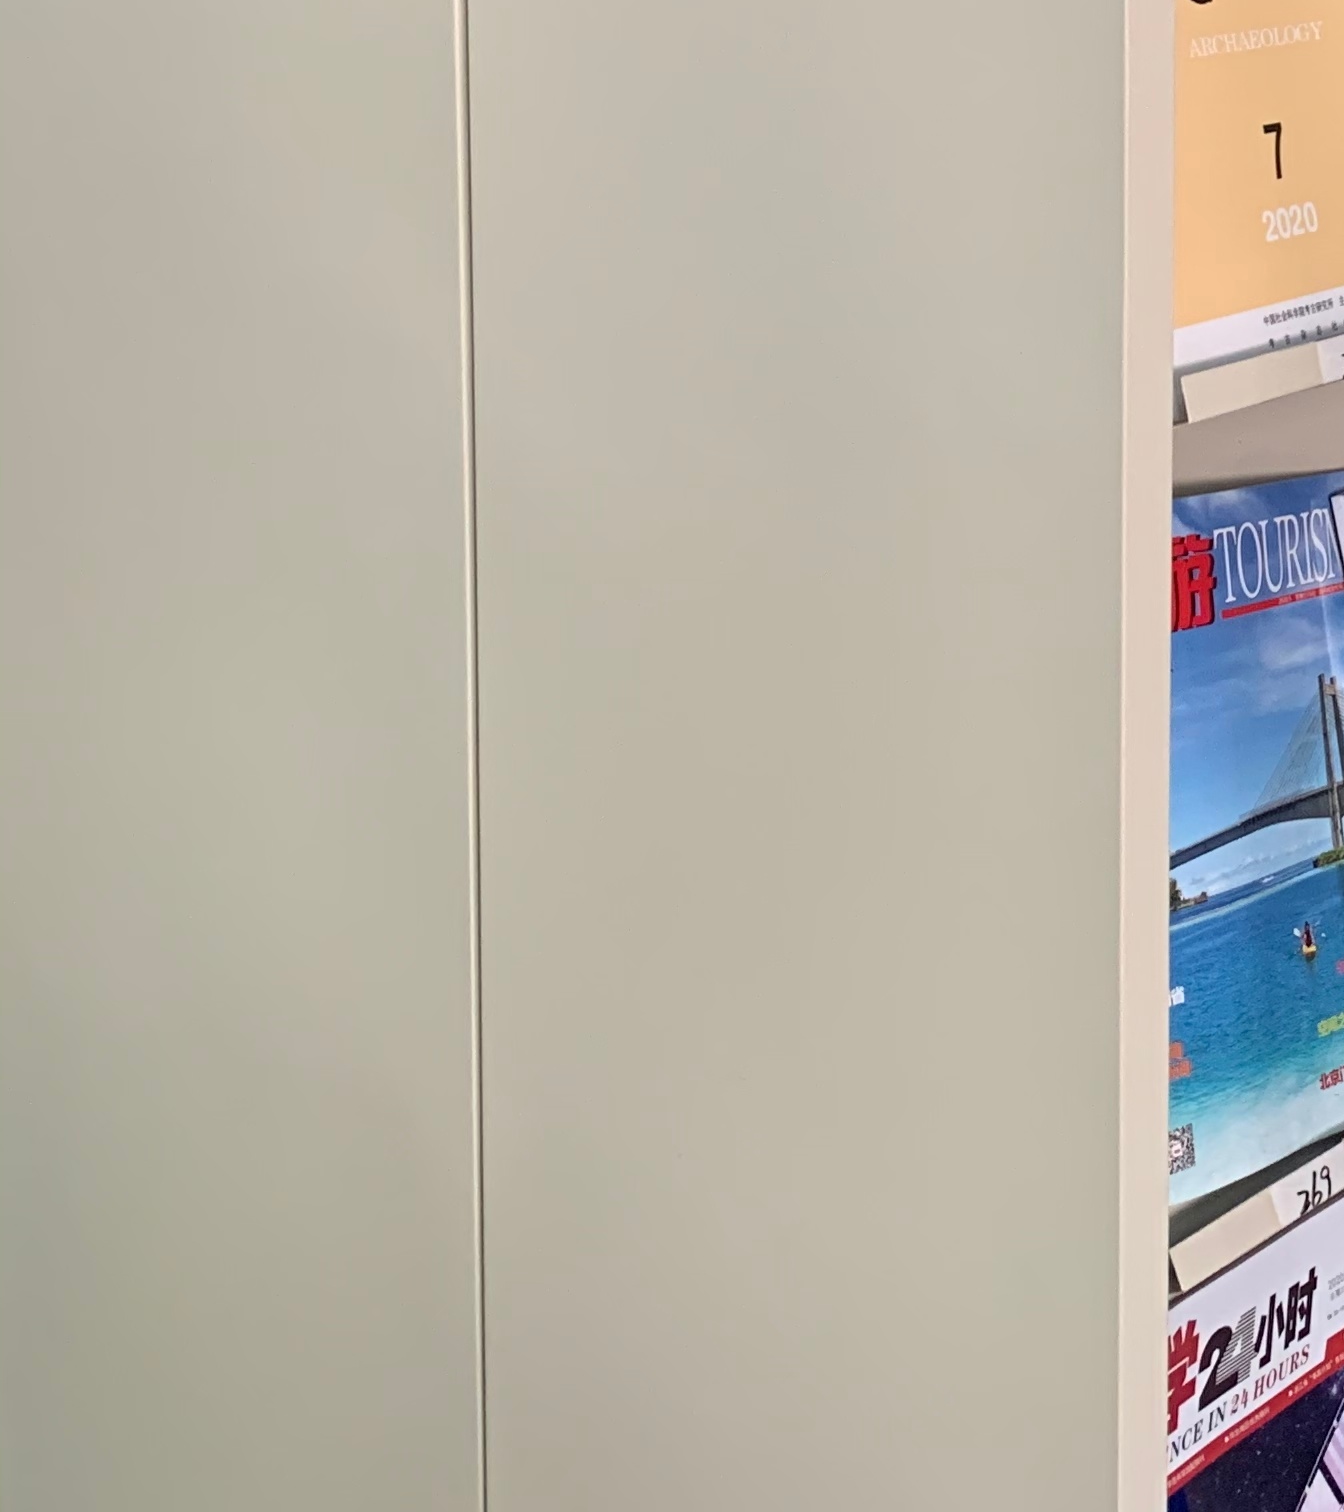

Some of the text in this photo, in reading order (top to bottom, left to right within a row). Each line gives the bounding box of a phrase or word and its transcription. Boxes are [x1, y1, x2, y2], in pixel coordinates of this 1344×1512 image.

[1190, 20, 1324, 58] ARCHAEOLOGY
[1262, 121, 1284, 180] 7
[1262, 200, 1319, 243] 2020
[1297, 1165, 1332, 1216] 269
[1207, 1403, 1229, 1435] IN
[1230, 1388, 1249, 1417] 24
[1252, 1344, 1310, 1401] HOURS
